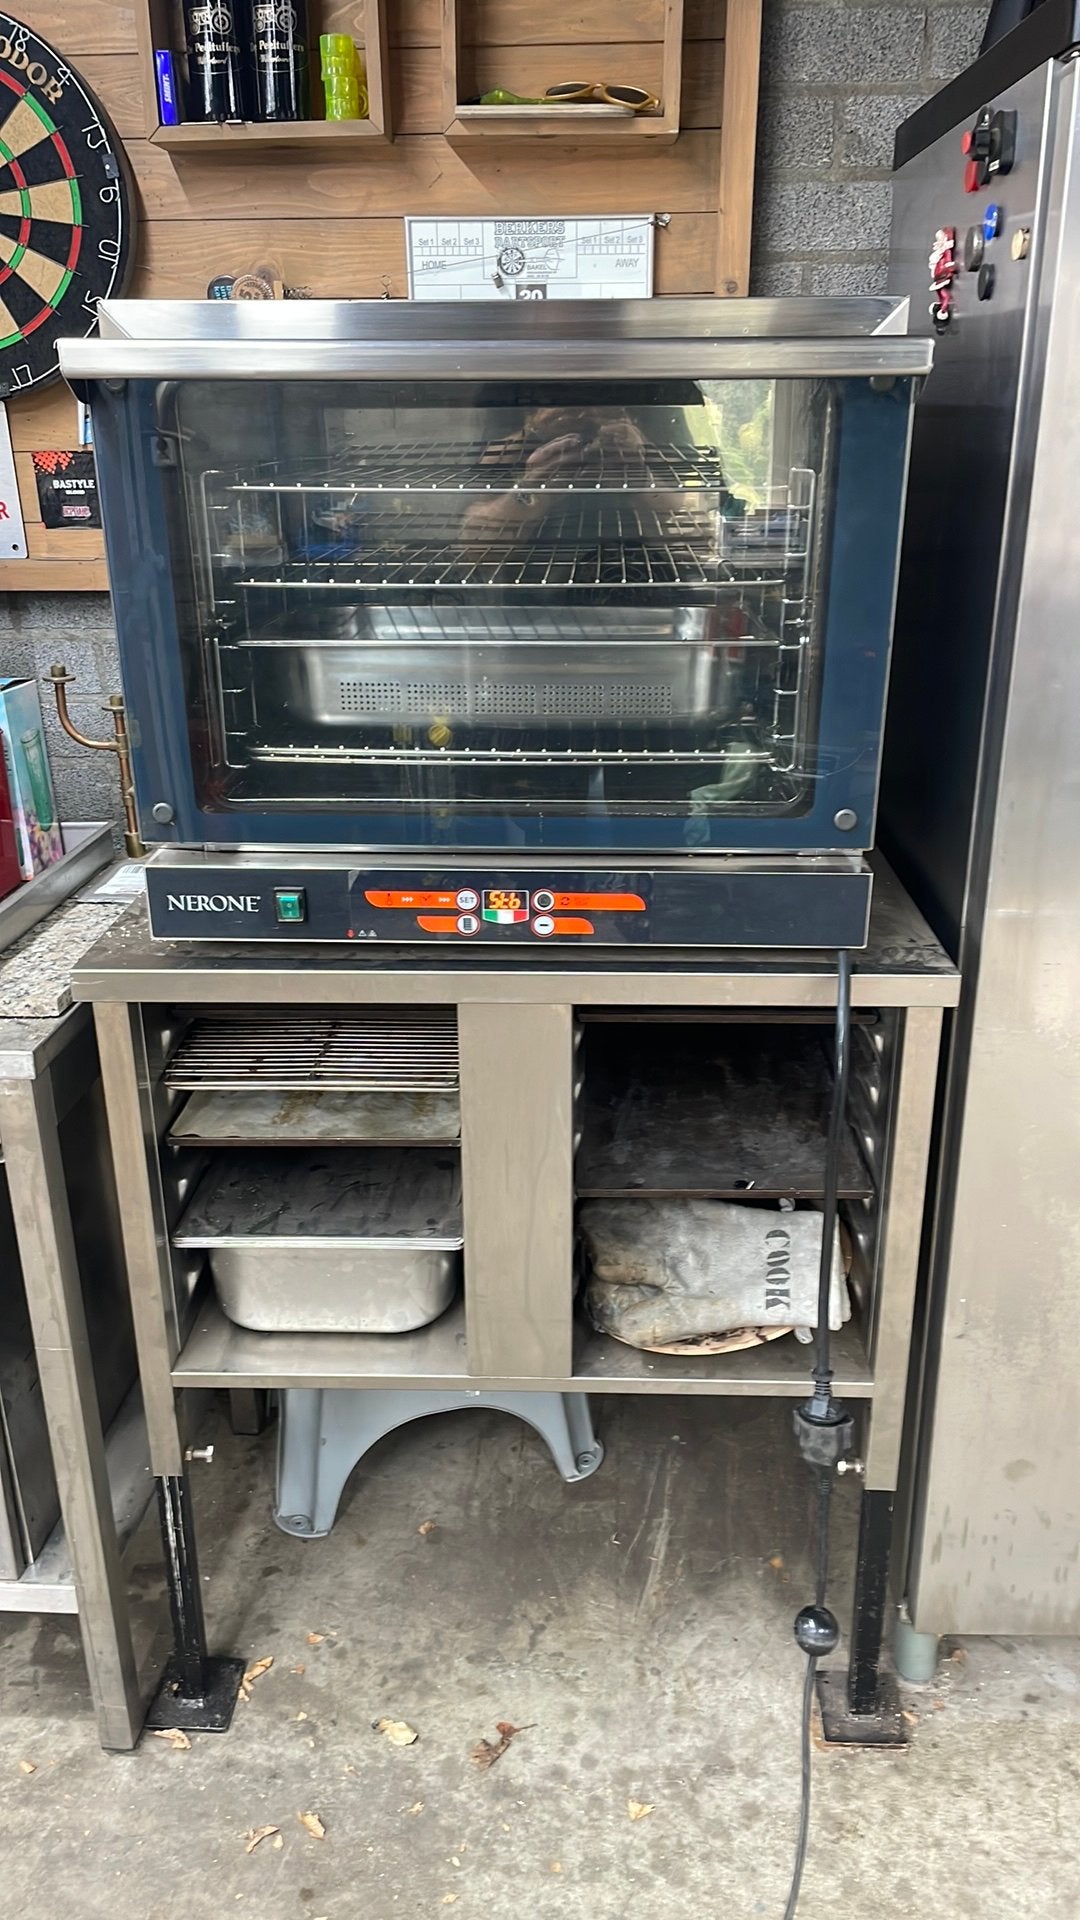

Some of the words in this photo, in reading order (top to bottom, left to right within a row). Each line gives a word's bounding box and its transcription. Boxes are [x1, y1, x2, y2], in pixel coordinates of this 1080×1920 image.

[494, 221, 566, 236] BERKERS
[422, 260, 447, 270] HOME
[615, 258, 639, 268] AWAY
[52, 479, 96, 489] BASTYLE
[166, 894, 261, 913] NERONE
[459, 896, 475, 904] SET
[765, 1229, 791, 1310] COOK
